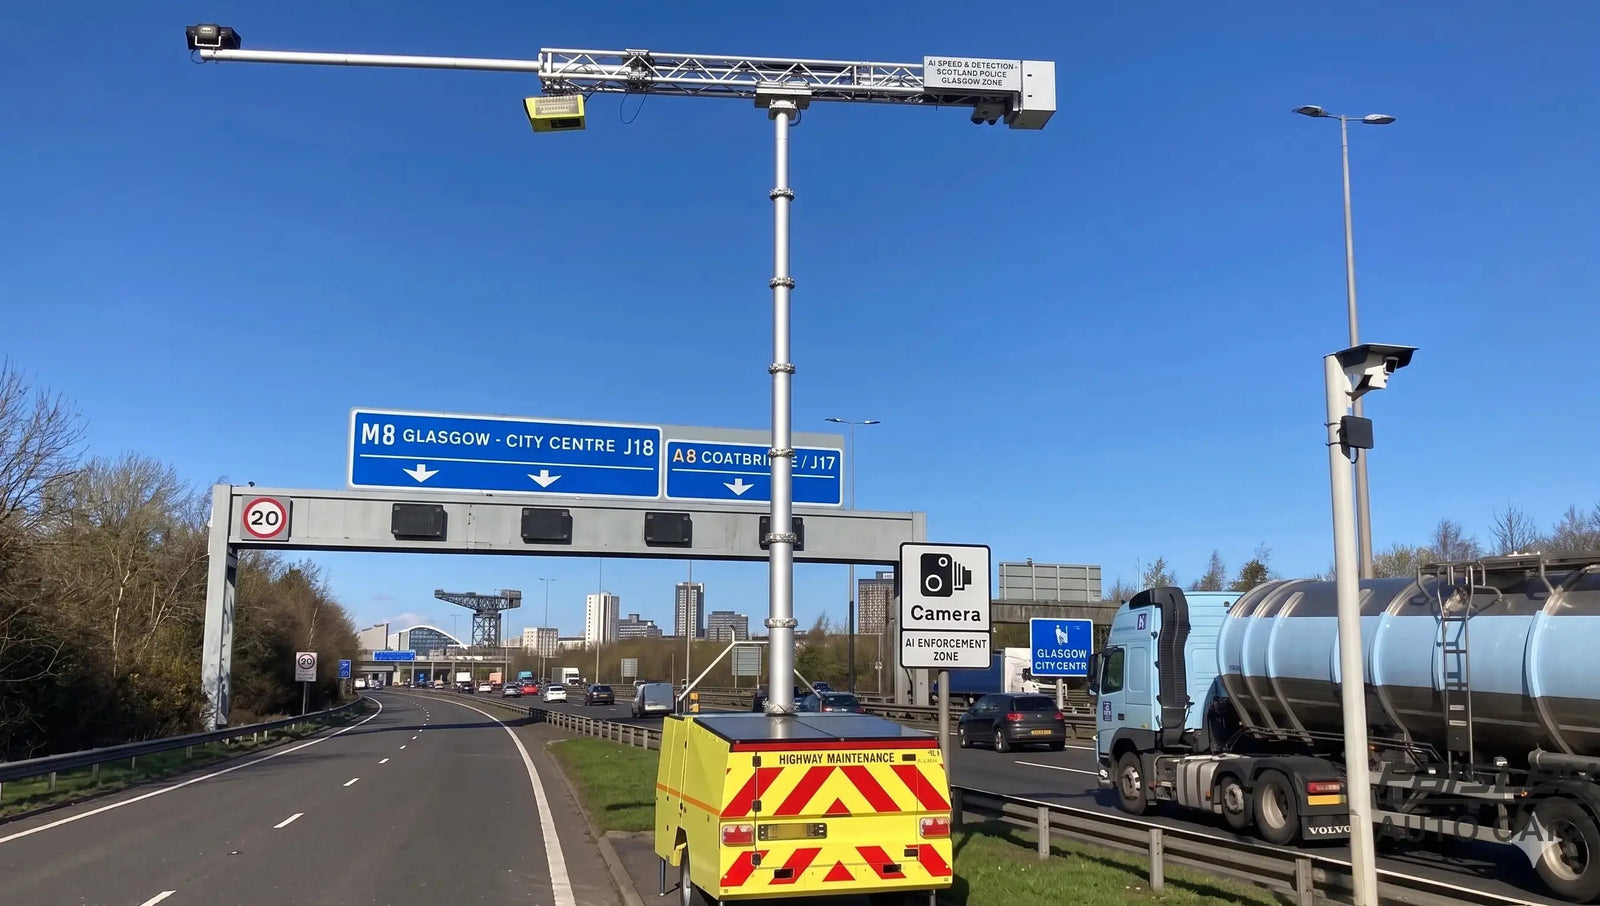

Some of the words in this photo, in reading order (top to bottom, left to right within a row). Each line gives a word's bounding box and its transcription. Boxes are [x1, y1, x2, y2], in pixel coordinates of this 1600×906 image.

[936, 68, 978, 76] SCOTLAND
[361, 422, 396, 446] M8
[402, 428, 490, 446] GLASGOW
[506, 434, 544, 448] CITY
[550, 436, 616, 452] CENTRE
[624, 438, 654, 456] J18
[672, 448, 696, 464] A8
[702, 450, 798, 468] COATBRIE
[801, 455, 808, 469] /
[810, 456, 835, 470] J17
[251, 510, 279, 526] 20
[911, 604, 981, 622] Camera
[906, 638, 914, 647] AI
[918, 638, 986, 648] ENFORCEMENT
[934, 652, 958, 661] ZONE
[1038, 649, 1087, 658] GLASGOW
[1035, 662, 1055, 670] CITY
[1056, 662, 1087, 670] CENTR
[780, 754, 823, 764] HIGHWAY
[827, 752, 895, 764] MAINTENANCE
[1308, 825, 1351, 834] VOLVO
